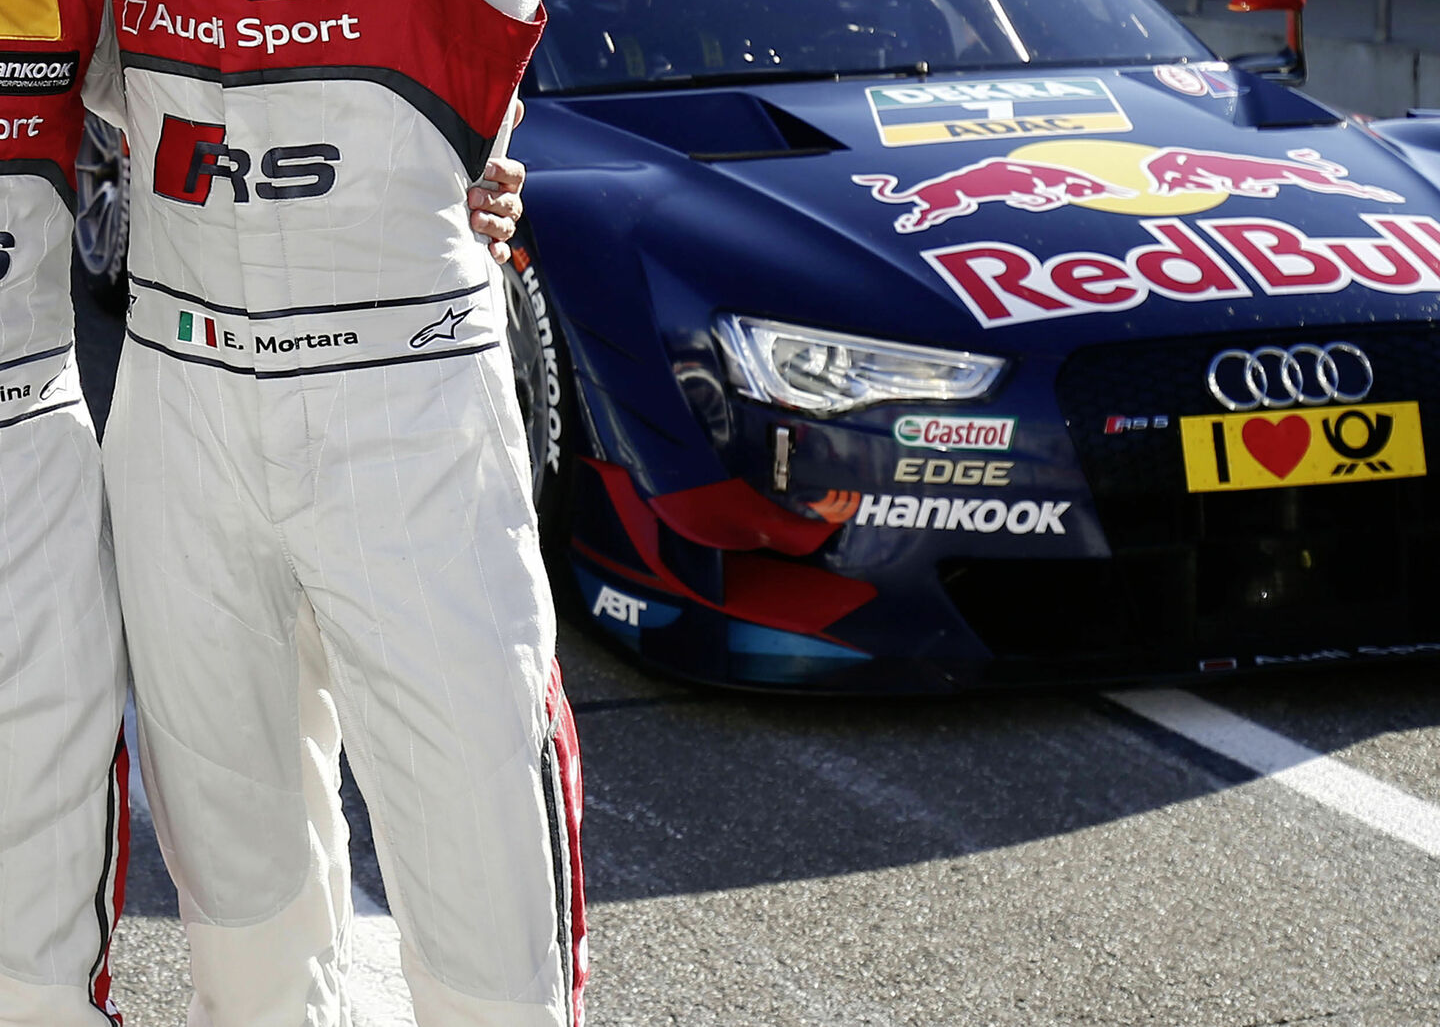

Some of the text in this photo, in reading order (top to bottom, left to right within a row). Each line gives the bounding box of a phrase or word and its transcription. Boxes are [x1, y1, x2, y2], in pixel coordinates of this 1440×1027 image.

[148, 3, 361, 54] Audi Sport
[881, 81, 1095, 104] DEKRA
[944, 118, 1085, 137] ADAC
[183, 142, 342, 203] RS
[934, 223, 1237, 320] Red
[223, 330, 359, 353] E. Mortara
[924, 420, 1008, 445] Castrol
[894, 458, 1015, 486] EDGE
[592, 585, 648, 626] ABT
